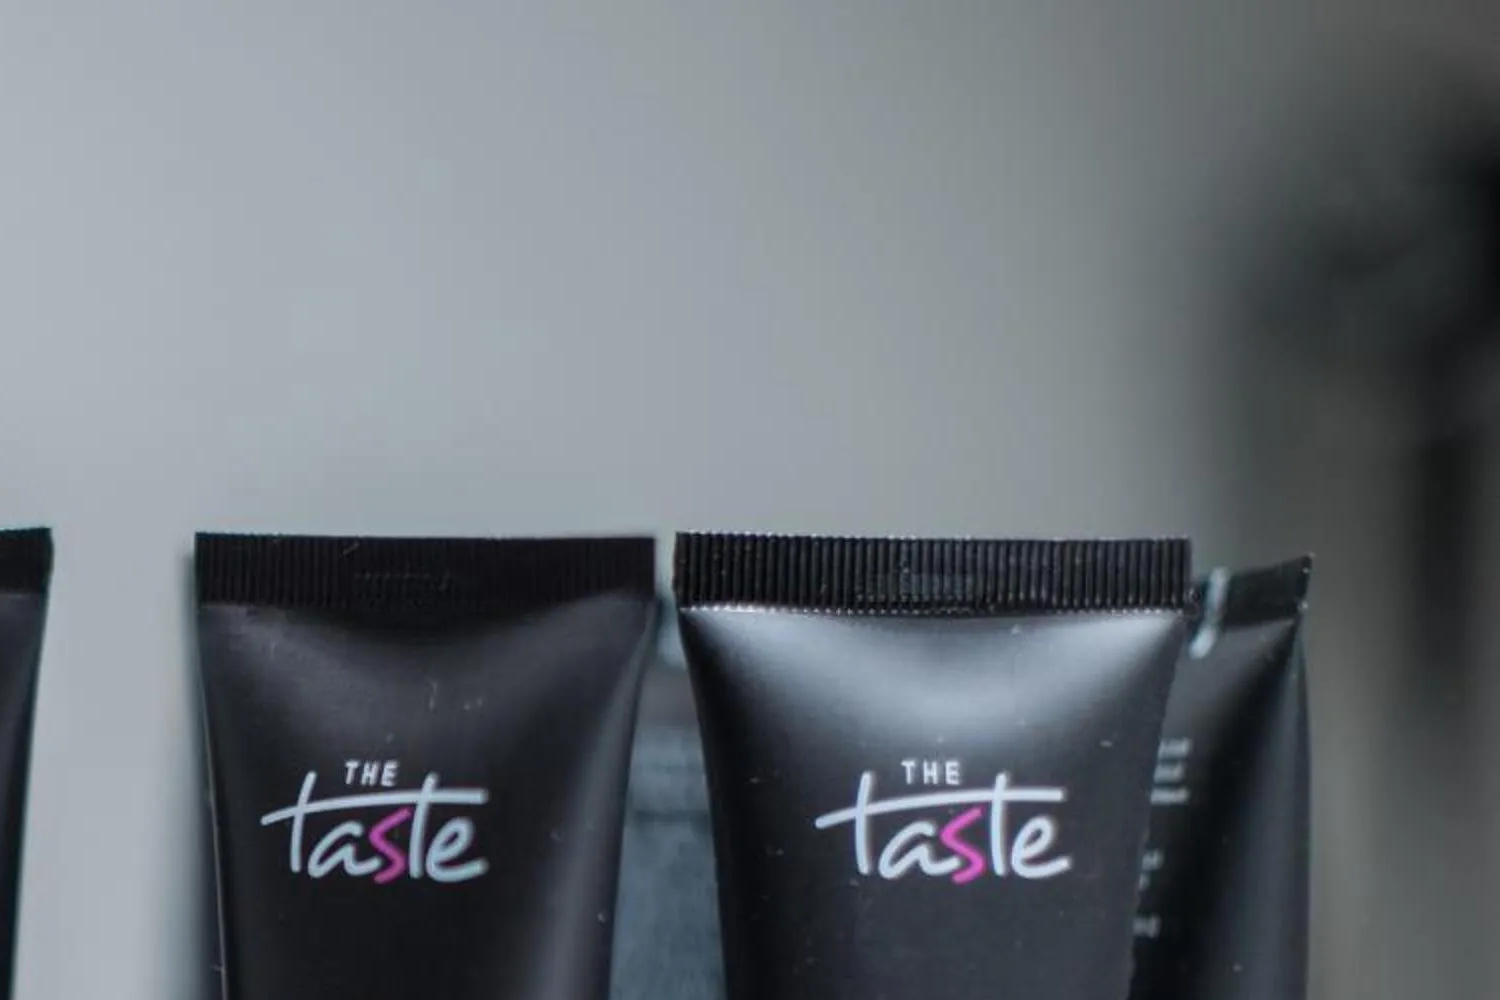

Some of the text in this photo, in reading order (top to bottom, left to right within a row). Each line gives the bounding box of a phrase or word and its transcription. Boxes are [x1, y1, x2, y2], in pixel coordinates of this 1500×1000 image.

[345, 760, 399, 786] THE
[901, 760, 961, 785] THE
[260, 771, 489, 883] taste
[815, 771, 1071, 884] taste
